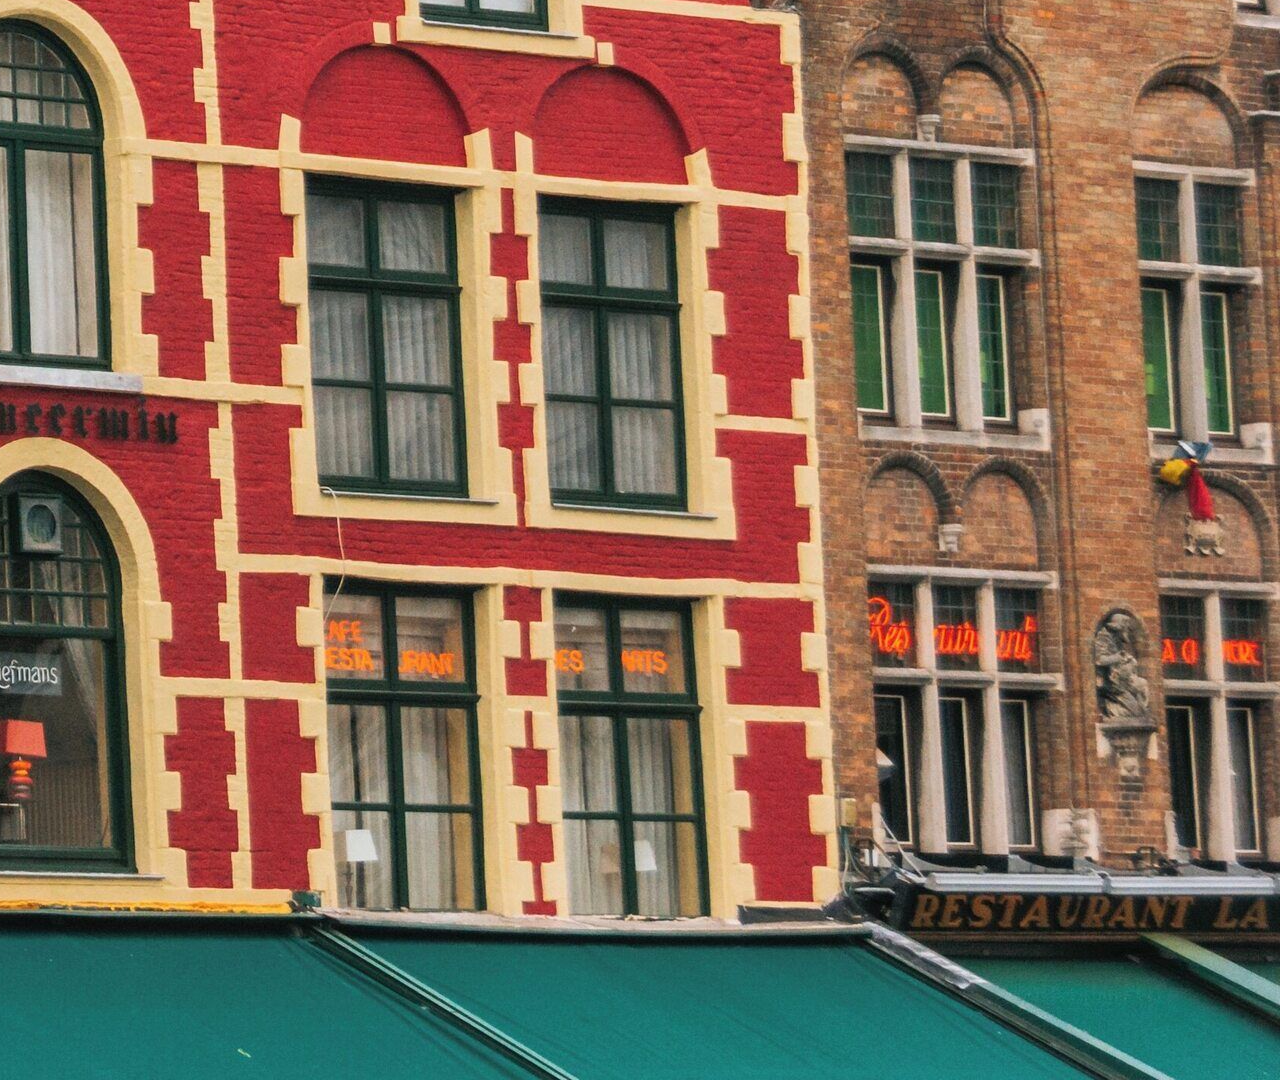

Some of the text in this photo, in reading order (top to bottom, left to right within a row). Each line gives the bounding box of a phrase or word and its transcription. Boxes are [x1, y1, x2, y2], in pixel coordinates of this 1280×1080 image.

[555, 648, 585, 674] ES
[911, 894, 1270, 930] RESTAURANT LA
